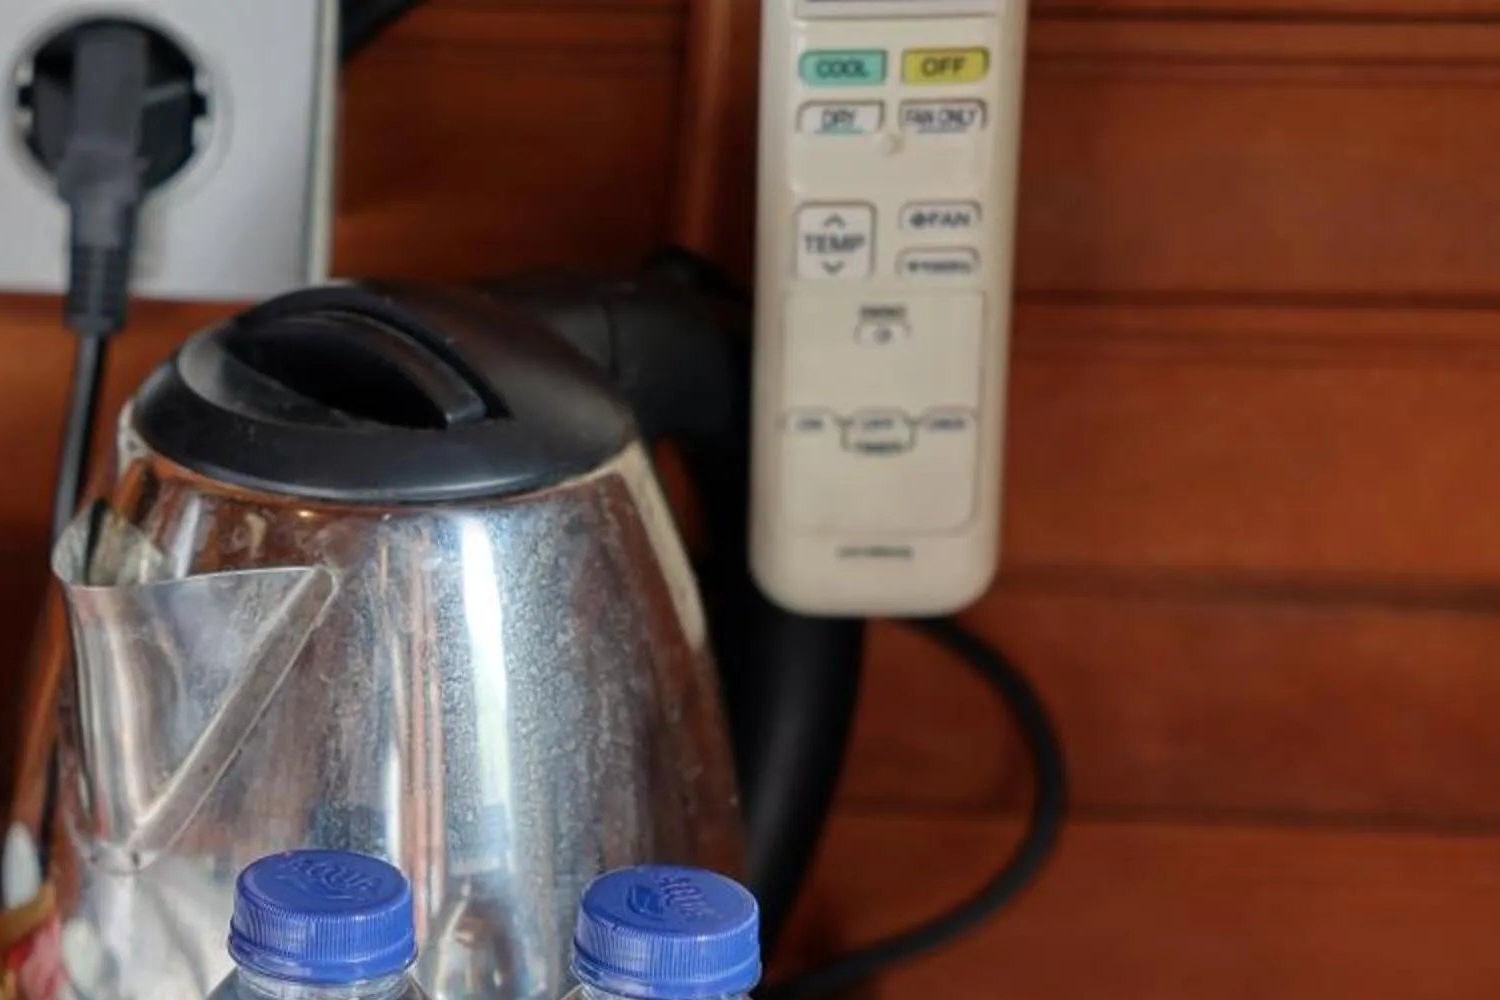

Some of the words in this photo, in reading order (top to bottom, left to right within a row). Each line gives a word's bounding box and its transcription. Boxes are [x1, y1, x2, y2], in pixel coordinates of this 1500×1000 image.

[815, 59, 869, 78] COOL
[920, 56, 966, 77] OFF
[804, 234, 865, 253] TEMP
